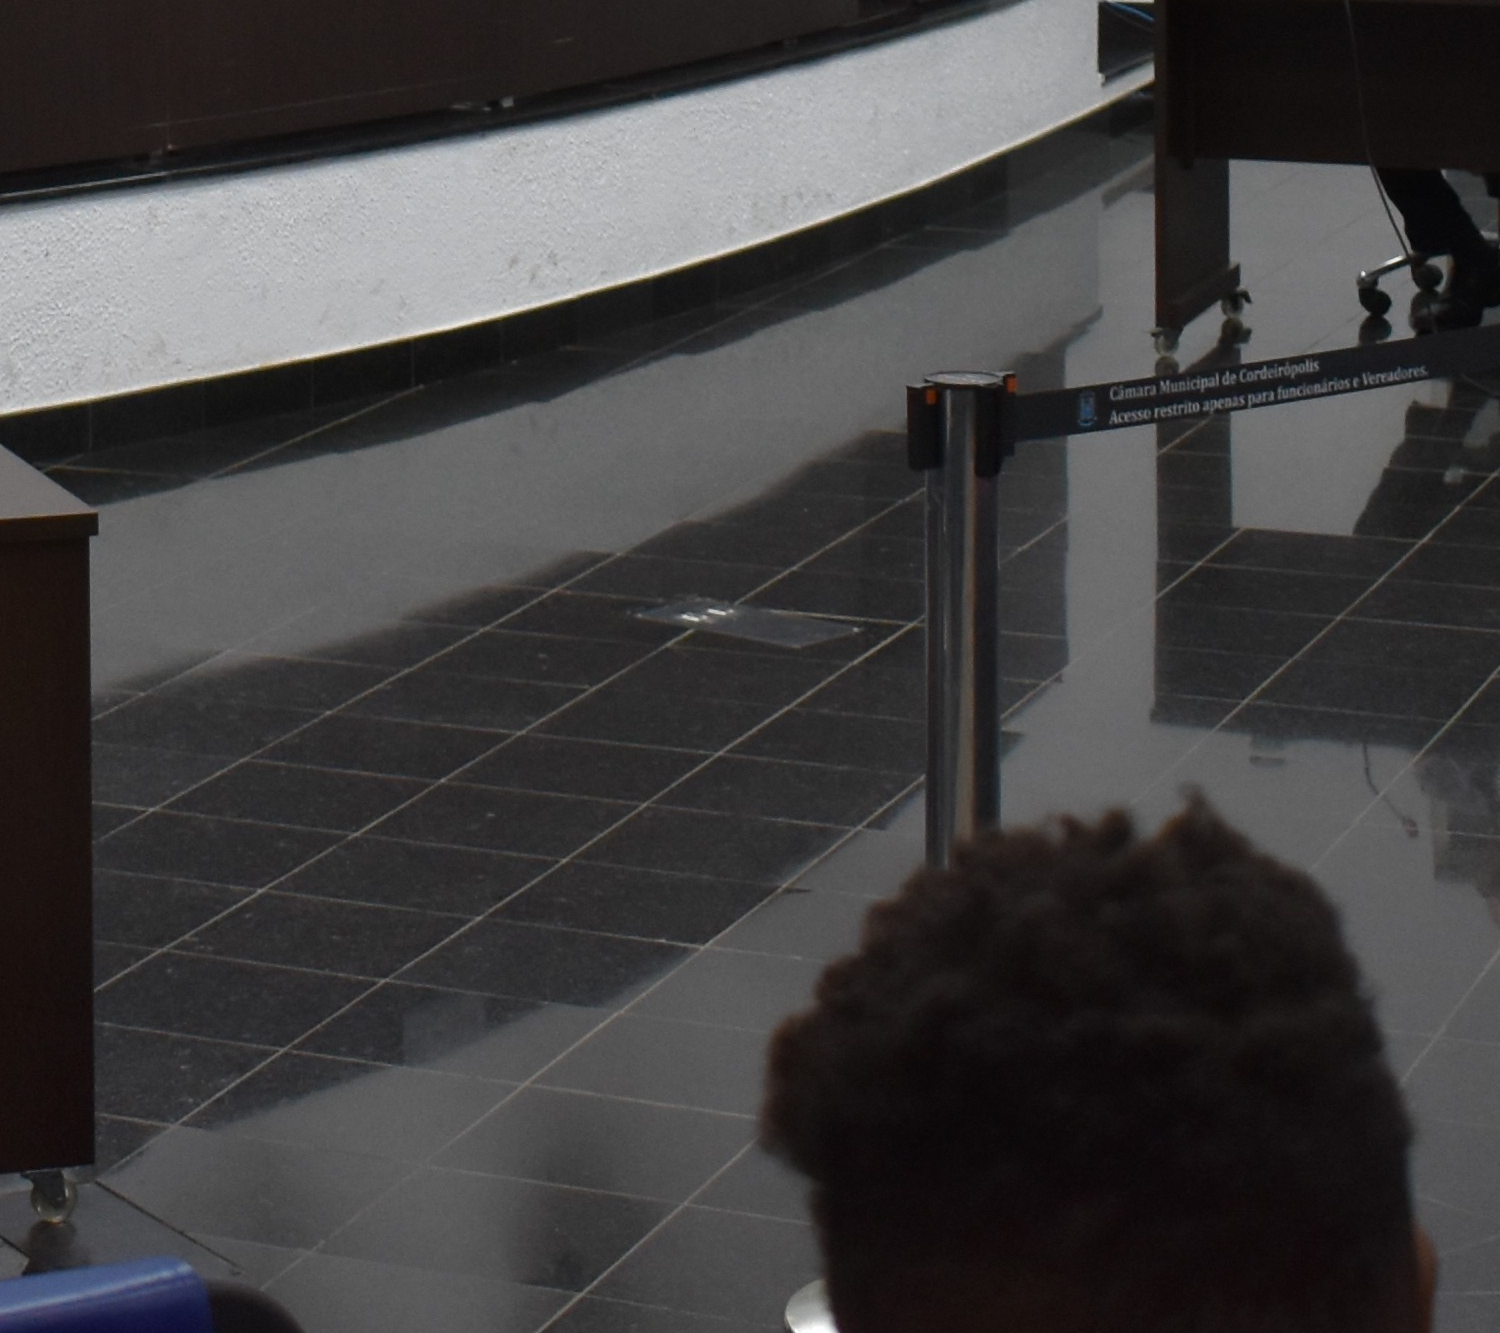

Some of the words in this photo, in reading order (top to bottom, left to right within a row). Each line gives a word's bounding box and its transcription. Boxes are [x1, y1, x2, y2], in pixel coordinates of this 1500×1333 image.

[1108, 406, 1152, 426] Acesso
[1154, 400, 1201, 420] restrito
[1202, 396, 1246, 415] apenas
[1247, 389, 1276, 410] para
[1353, 376, 1360, 388] e
[1160, 374, 1220, 396] Municipal
[1221, 371, 1238, 385] de
